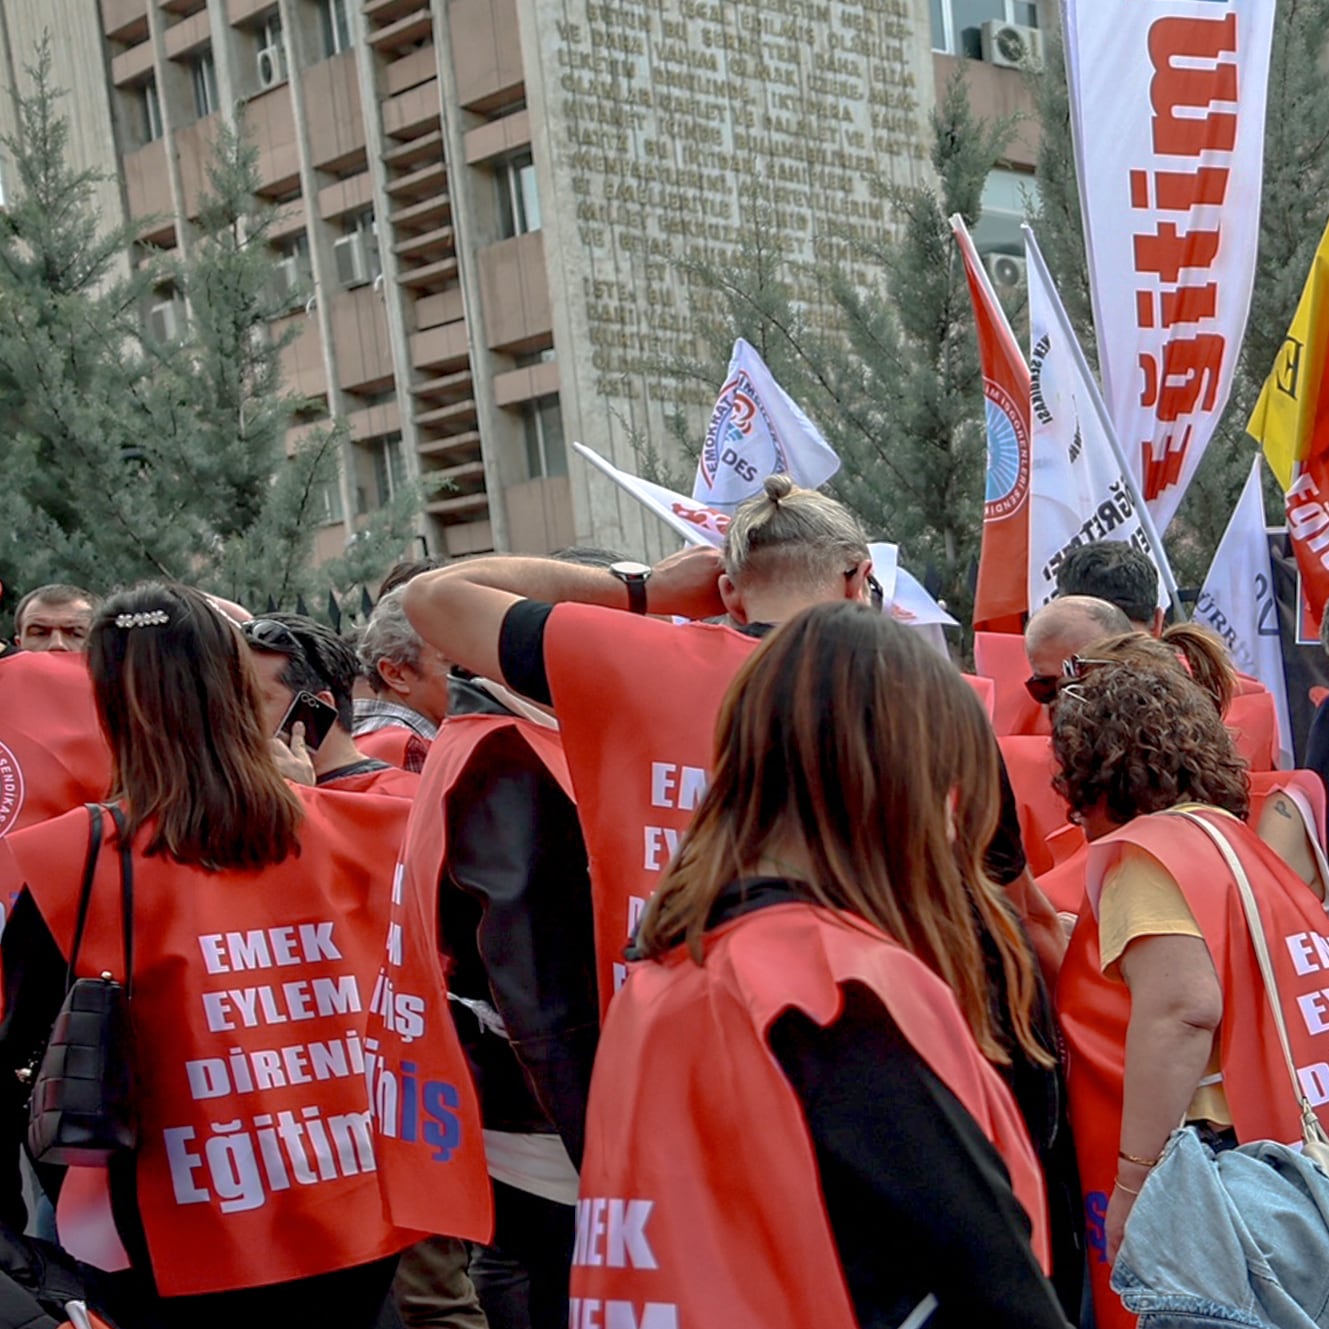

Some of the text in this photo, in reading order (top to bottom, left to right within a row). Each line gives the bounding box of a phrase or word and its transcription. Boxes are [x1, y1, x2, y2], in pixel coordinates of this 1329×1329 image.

[1129, 12, 1240, 502] Eğitim
[721, 449, 759, 484] DES
[198, 921, 344, 976] EMEK
[202, 974, 362, 1034] EYLEM
[185, 1029, 367, 1102] DİRENİ
[163, 1109, 379, 1214] Eğitim
